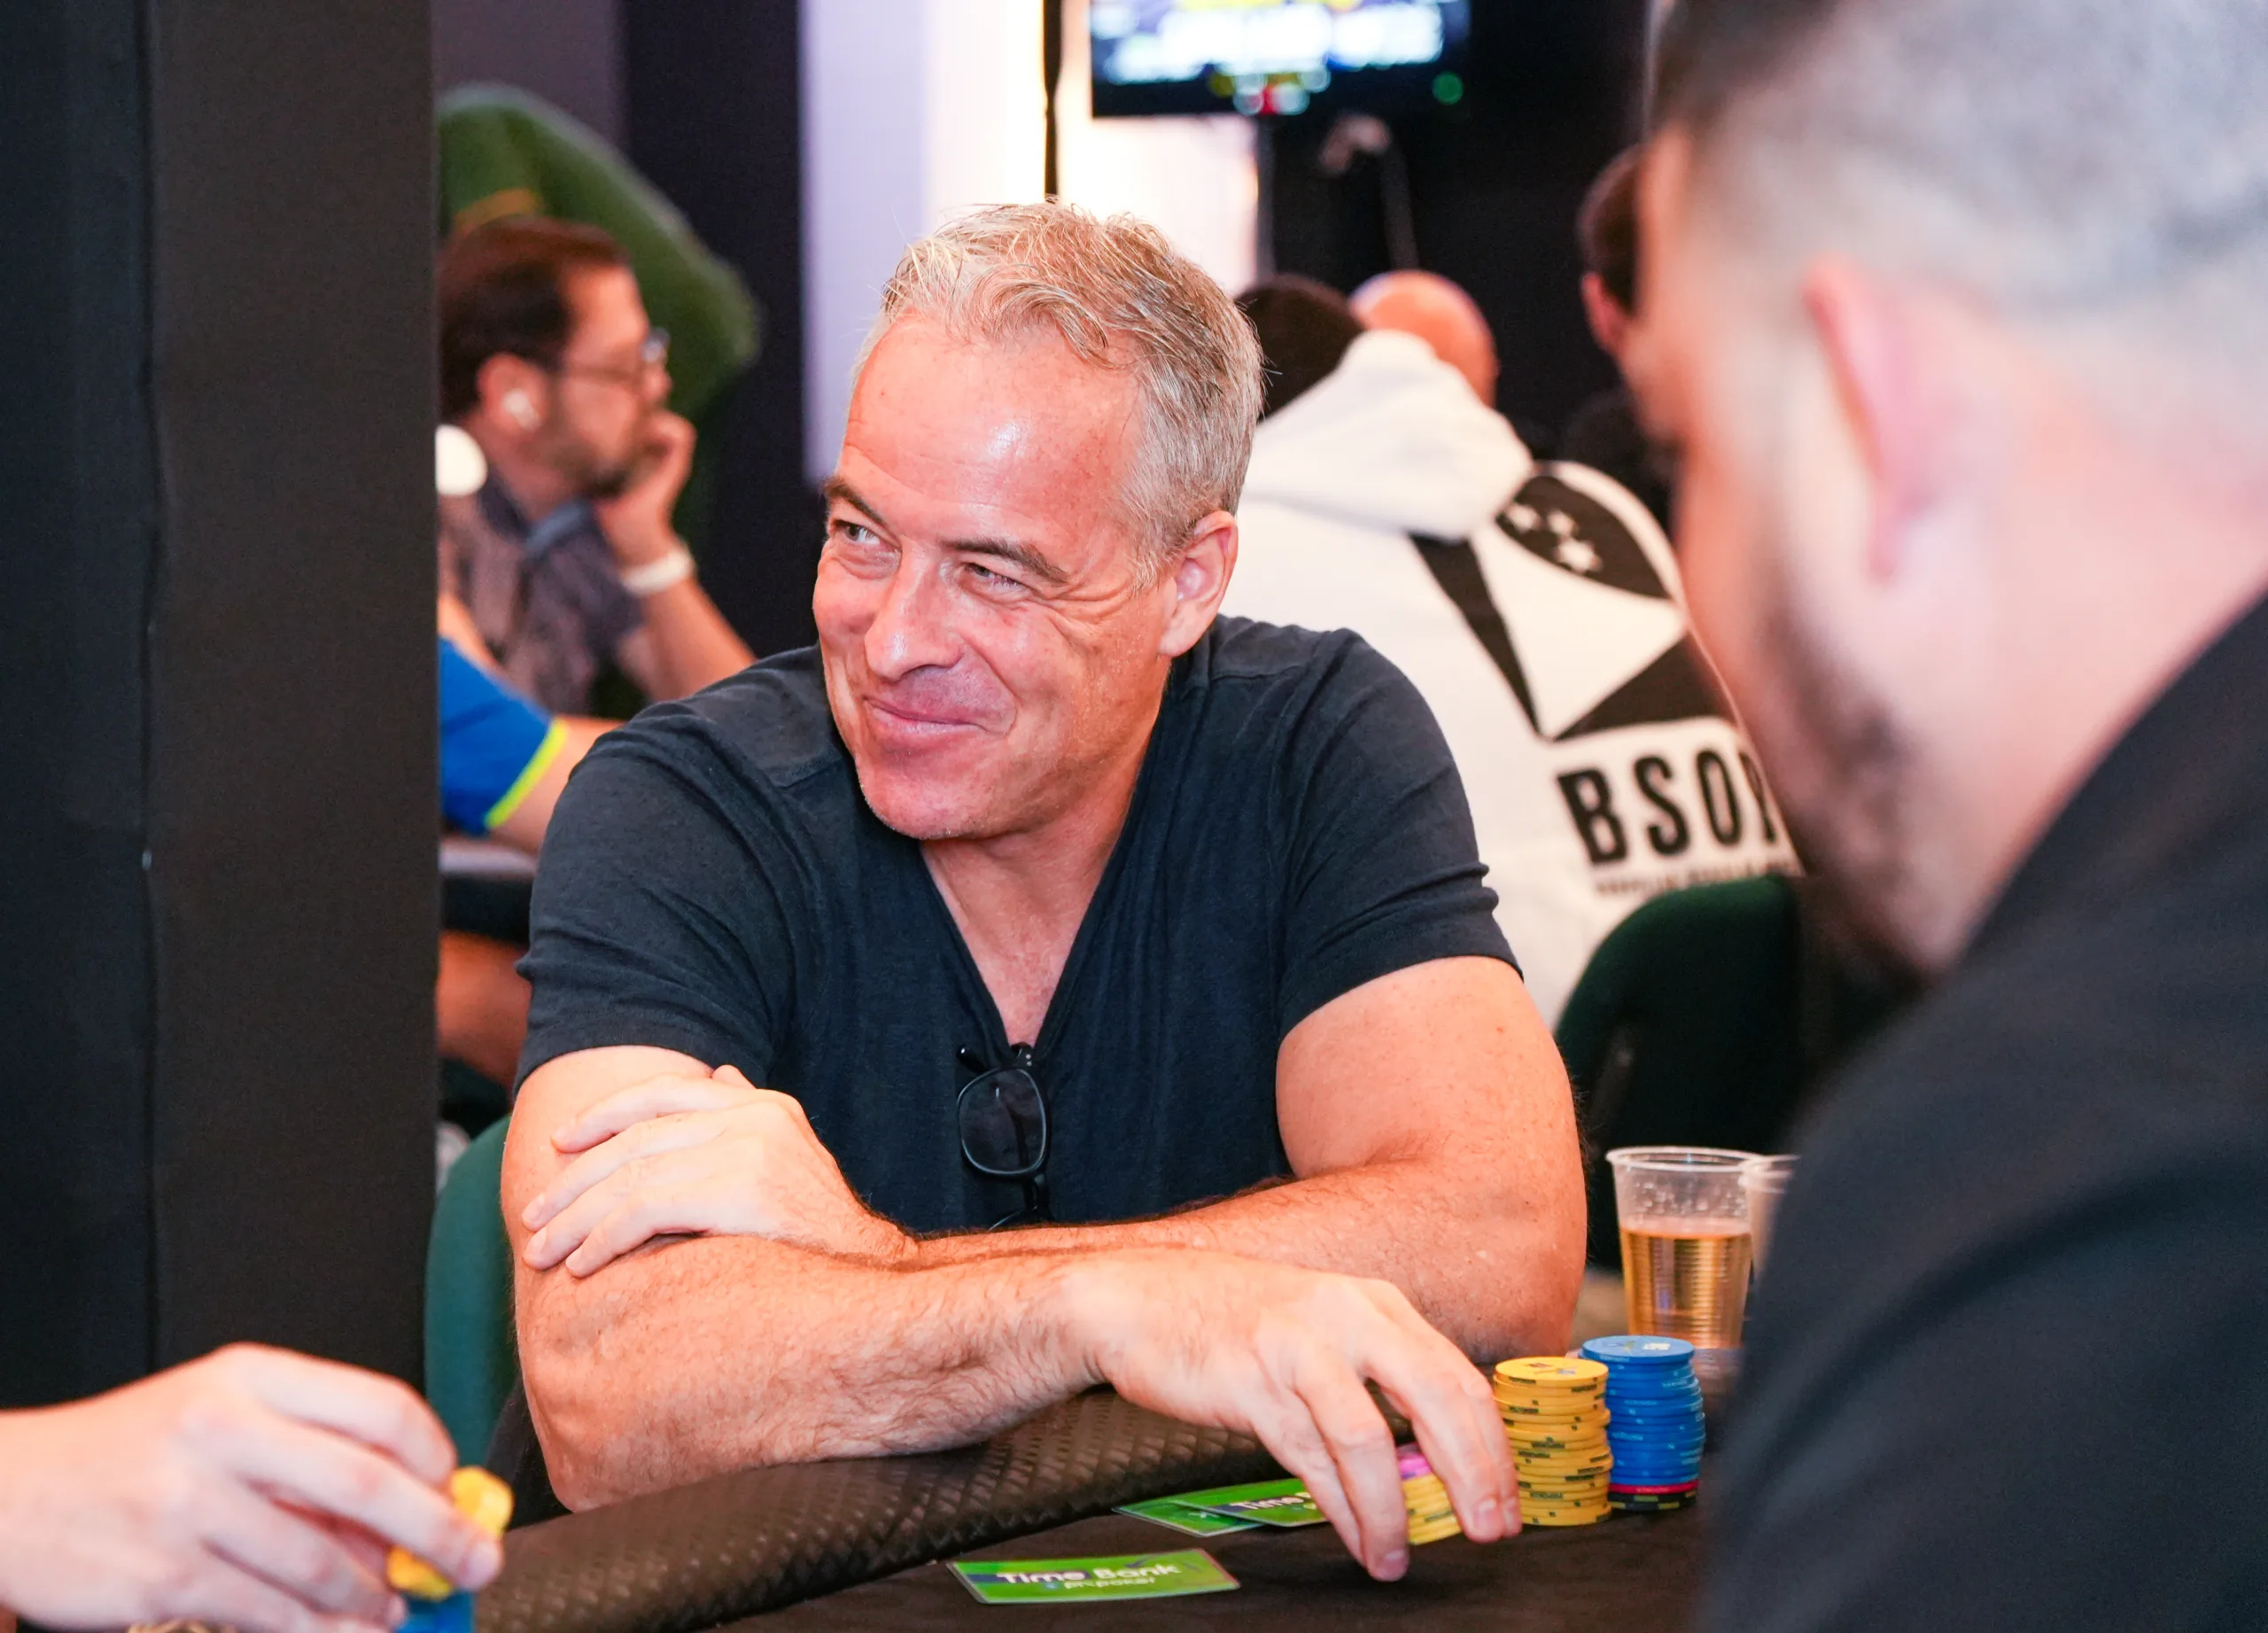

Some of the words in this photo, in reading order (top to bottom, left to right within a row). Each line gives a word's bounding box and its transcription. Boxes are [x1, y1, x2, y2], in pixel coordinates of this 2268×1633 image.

[1229, 1496, 1304, 1510] Time
[996, 1571, 1086, 1583] Time
[1093, 1563, 1181, 1579] Bank
